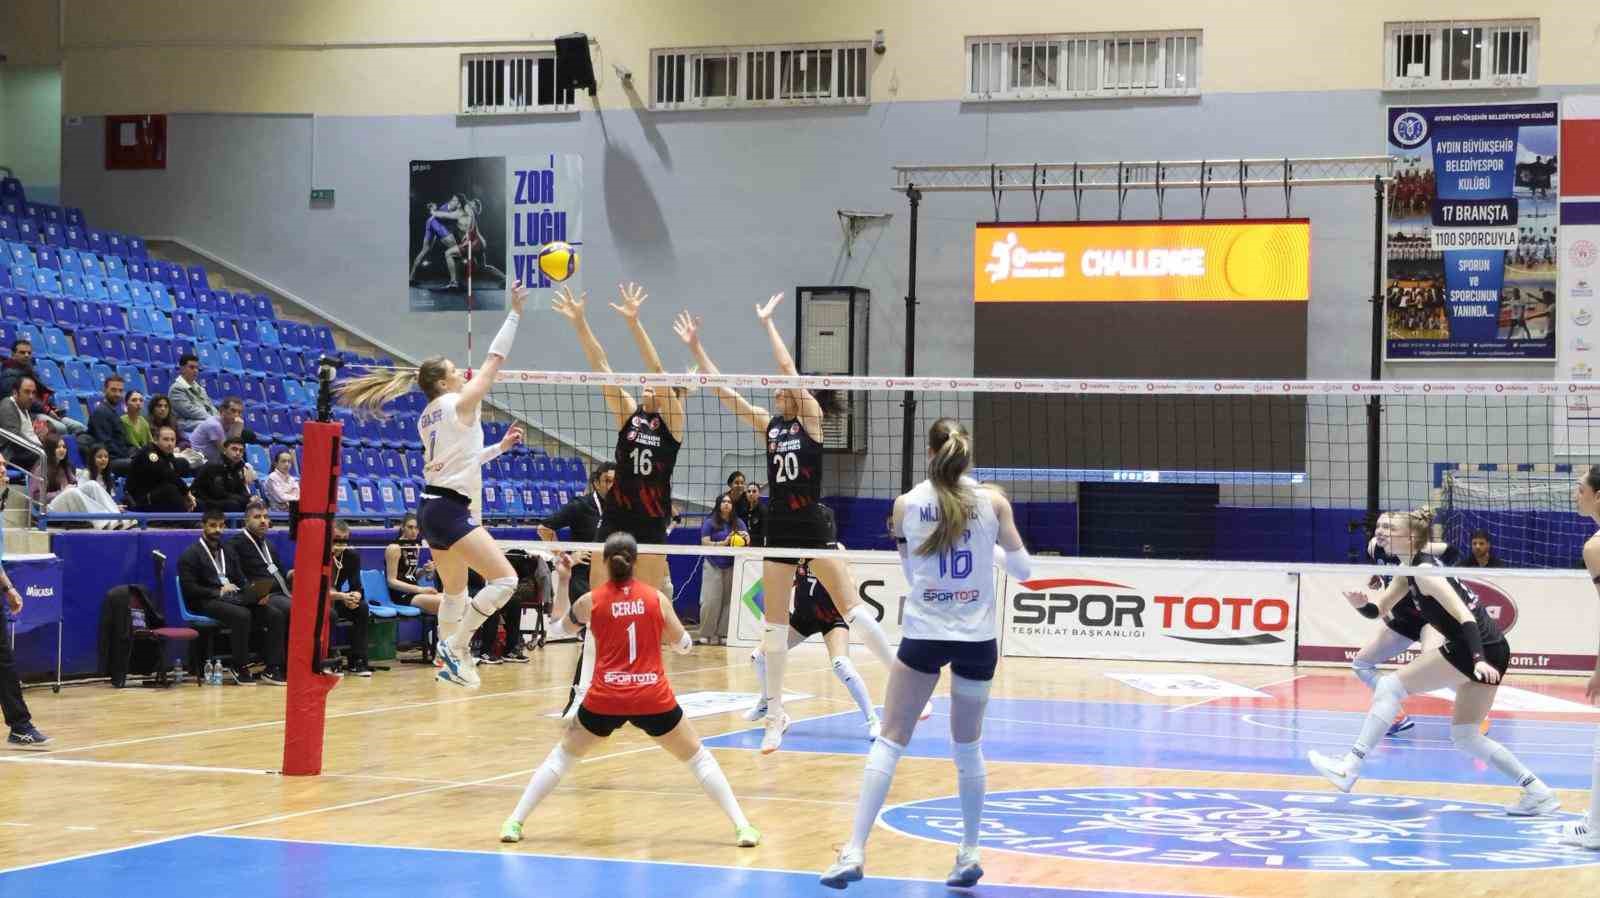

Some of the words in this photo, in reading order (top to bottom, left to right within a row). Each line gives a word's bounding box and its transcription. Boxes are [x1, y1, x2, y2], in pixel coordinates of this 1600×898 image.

[1436, 141, 1462, 154] AYDIN
[1463, 137, 1514, 156] BÜYÜKŞEHİR
[1445, 158, 1504, 173] BELEDİYESPOR
[514, 169, 554, 205] ZOR
[1458, 176, 1491, 191] KULÜBÜ
[1442, 206, 1453, 222] 17
[1456, 204, 1509, 225] BRANŞTA
[514, 209, 567, 246] LUĞU
[1436, 233, 1456, 247] 1100
[1458, 231, 1516, 247] SPORCUYLA
[1081, 247, 1205, 277] CHALLENGE
[1458, 259, 1491, 272] SPORUN
[1469, 276, 1479, 287] ve
[1450, 289, 1498, 302] SPORCUNUN
[629, 447, 653, 476] 16
[772, 452, 800, 483] 20
[808, 578, 819, 597] 7
[611, 598, 646, 619] ÇERAĞ
[1013, 593, 1146, 628] SPOR
[1153, 596, 1290, 632] TOTO
[1012, 626, 1067, 637] TEŞKİLAT
[1071, 629, 1146, 639] BAŞKANLIĞI
[626, 621, 638, 666] 1
